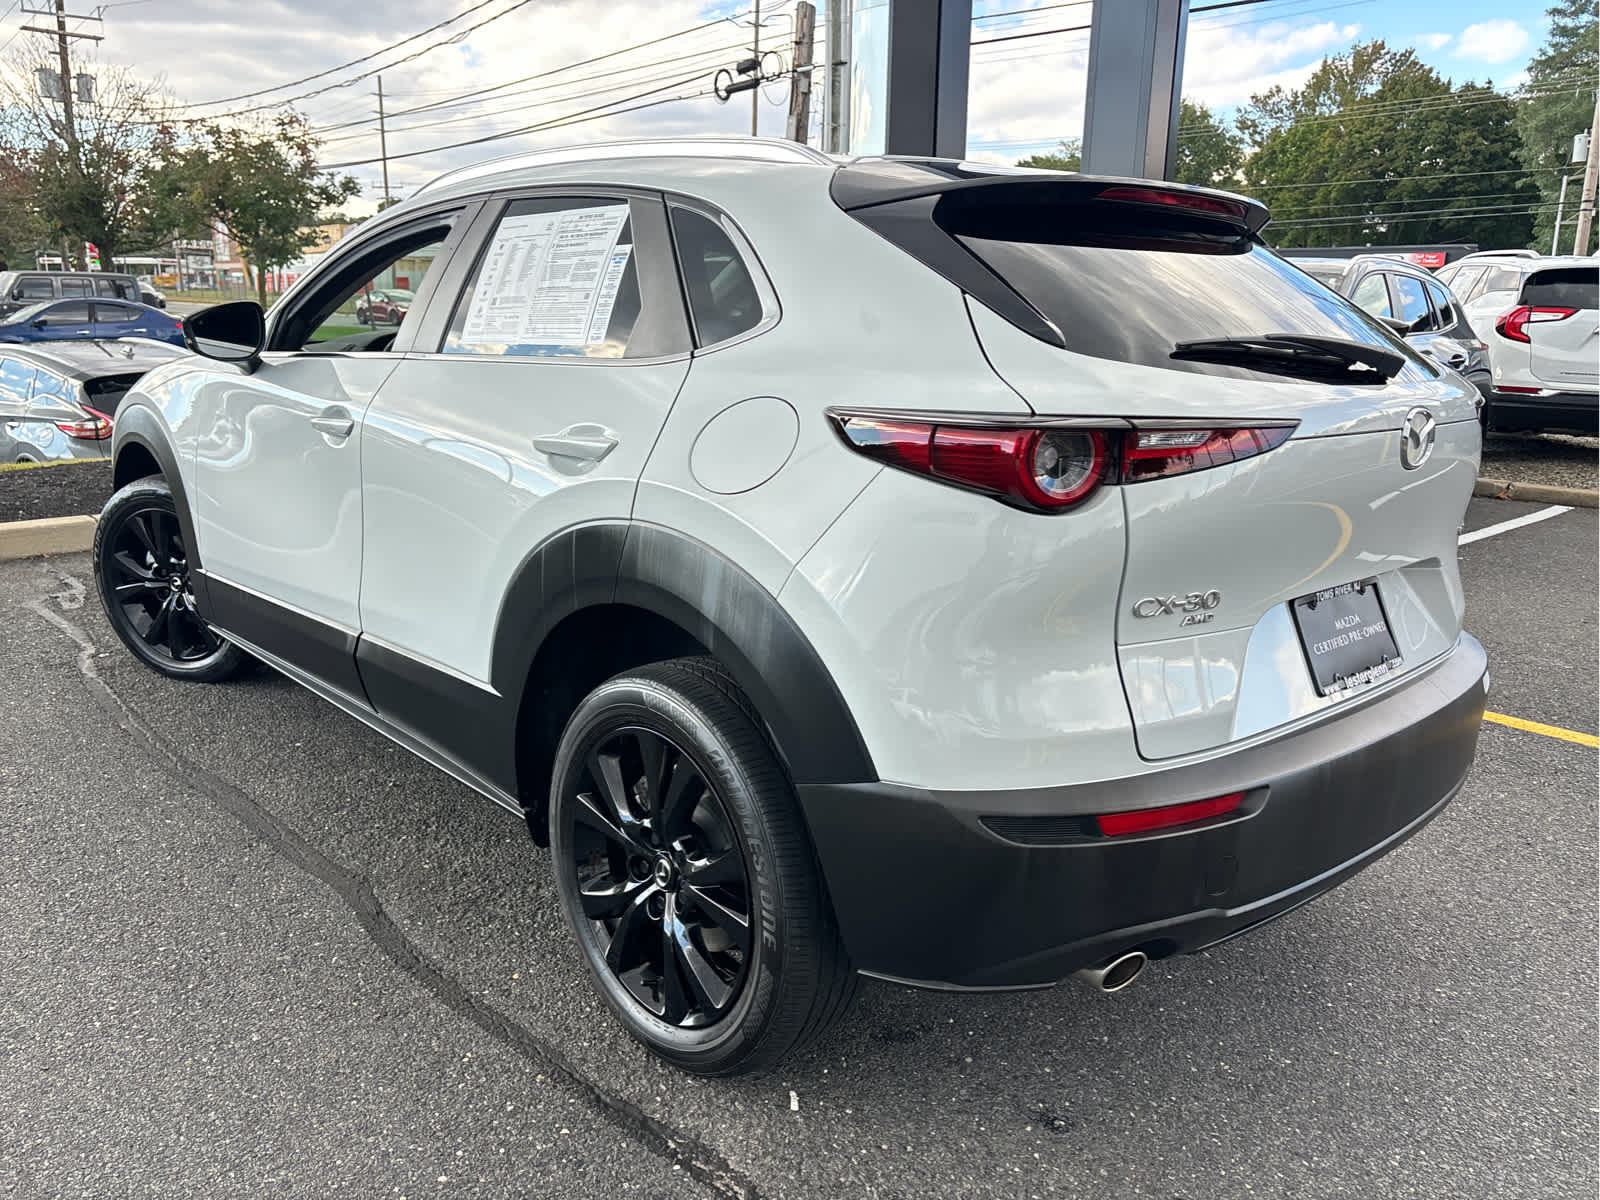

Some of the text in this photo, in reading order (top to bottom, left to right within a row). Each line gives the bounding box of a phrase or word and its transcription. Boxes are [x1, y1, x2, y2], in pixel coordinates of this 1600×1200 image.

[1316, 586, 1334, 601] TOMS
[1353, 581, 1361, 591] NJ
[1132, 589, 1221, 618] CX-30
[1179, 612, 1214, 627] AWD
[1334, 614, 1361, 630] MAZDA
[1313, 620, 1386, 655] CERTIFIED PRE-OWNED
